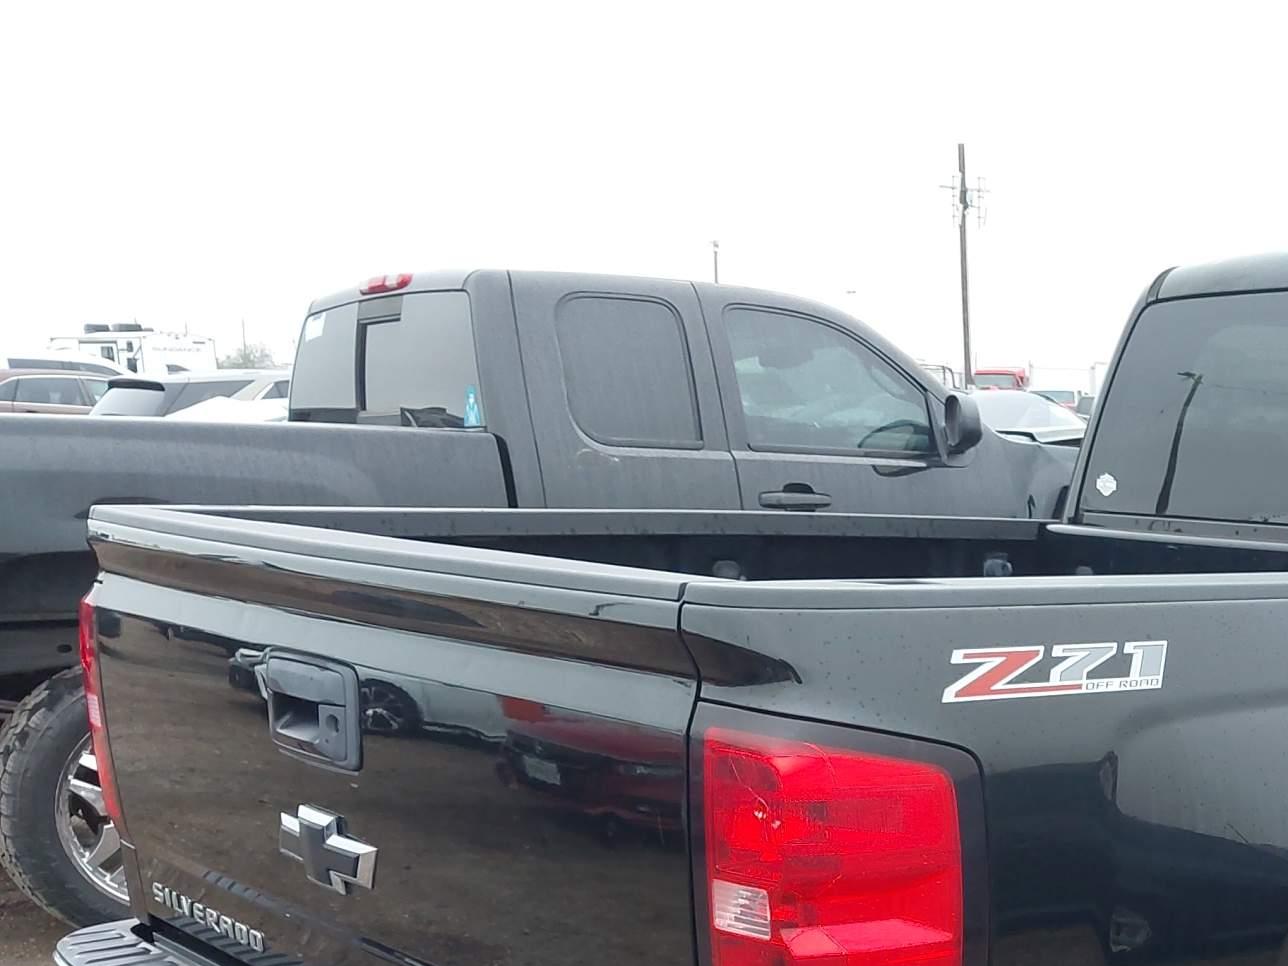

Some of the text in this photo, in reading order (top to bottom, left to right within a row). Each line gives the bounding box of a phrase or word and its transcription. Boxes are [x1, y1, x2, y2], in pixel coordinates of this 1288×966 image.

[942, 640, 1168, 703] Z71
[1086, 677, 1160, 691] OFF ROAD
[152, 882, 264, 953] SILVERADO
